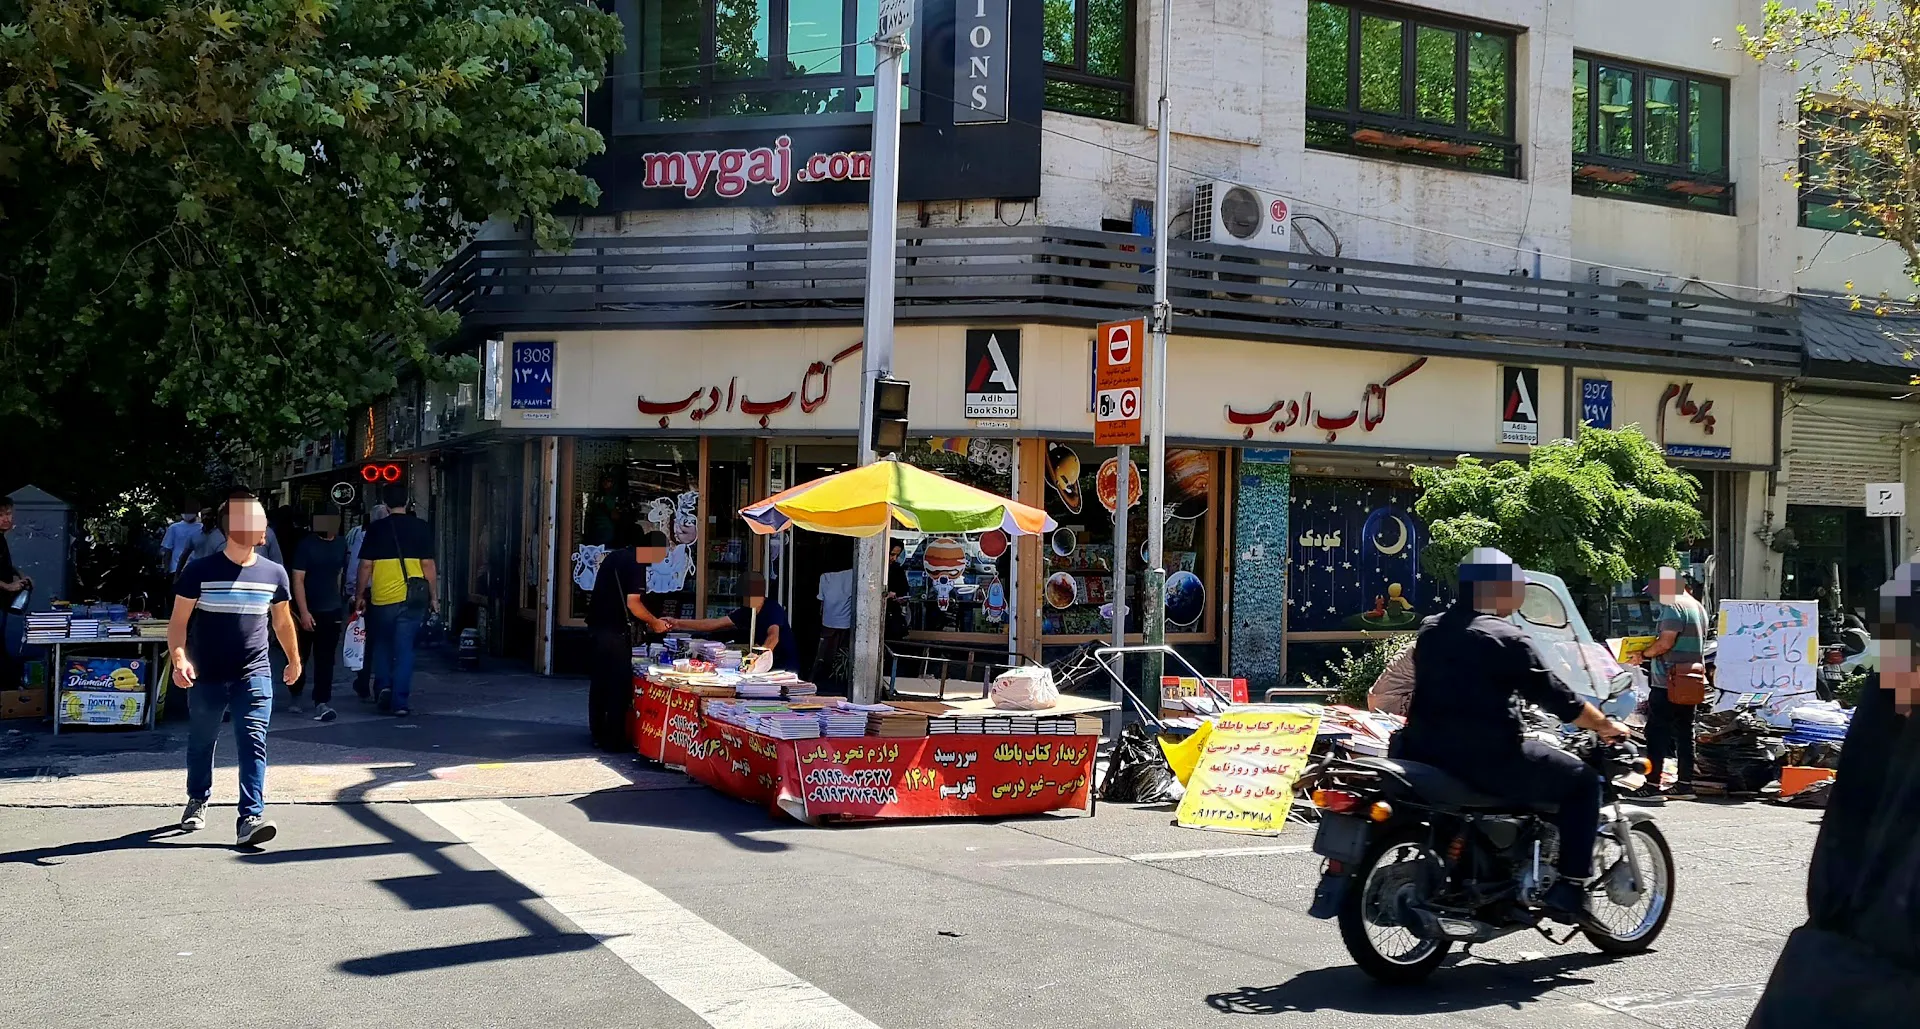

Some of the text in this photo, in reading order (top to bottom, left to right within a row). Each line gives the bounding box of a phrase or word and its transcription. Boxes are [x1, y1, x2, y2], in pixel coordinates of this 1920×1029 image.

[1271, 224, 1285, 236] LG
[515, 348, 551, 363] 1308
[514, 368, 552, 383] ۱۳۰۸
[1584, 383, 1609, 400] 297
[637, 376, 738, 429] ادیب
[1223, 357, 1428, 443] کتاب ادیب
[967, 406, 1016, 415] BookShop
[1584, 404, 1609, 421] ۲۹۷
[1511, 423, 1527, 431] Adib
[1502, 432, 1537, 441] BookShop
[1299, 529, 1341, 552] کودک
[68, 675, 115, 688] Diamante
[1246, 721, 1273, 733] کتاب
[801, 743, 899, 765] لوازم تحریر یاس
[993, 743, 1089, 767] خریدار کتاب باطله
[1243, 742, 1261, 754] غیر
[1263, 746, 1270, 755] و
[1272, 745, 1307, 756] درسی
[1209, 762, 1291, 776] کاغذ و روزنامه
[905, 768, 936, 791] ۱۴۰۲
[1027, 773, 1044, 798] غیر
[1057, 773, 1086, 796] درسی
[939, 776, 977, 799] تقویم
[992, 777, 1025, 799] درسی
[1244, 789, 1251, 798] و
[1254, 785, 1282, 799] رمان
